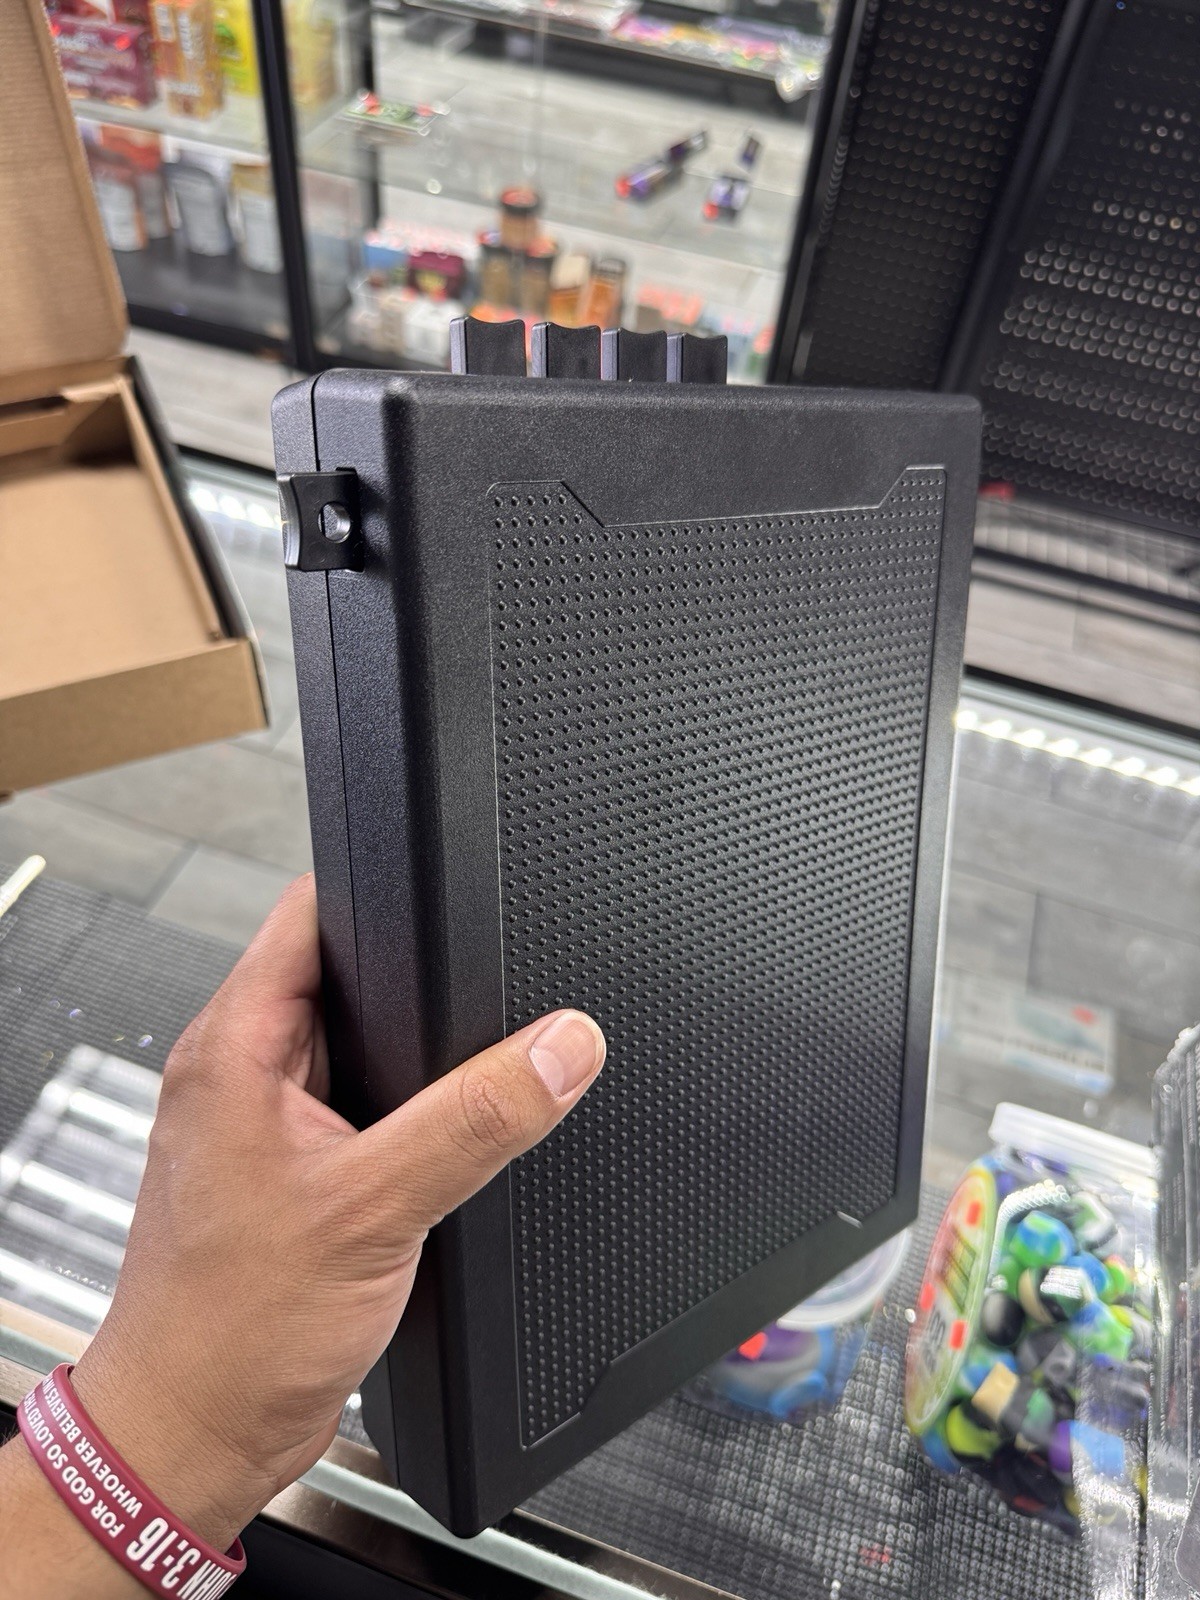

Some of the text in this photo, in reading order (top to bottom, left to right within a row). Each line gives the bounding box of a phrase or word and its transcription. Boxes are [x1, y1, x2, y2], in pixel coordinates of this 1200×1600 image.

[26, 1407, 54, 1449] LOVED
[44, 1387, 82, 1443] BELIEVES
[46, 1443, 69, 1469] SO
[61, 1465, 95, 1505] GOD
[74, 1436, 143, 1519] WHOEVER
[91, 1499, 125, 1538] FOR
[126, 1517, 201, 1589] 3:16
